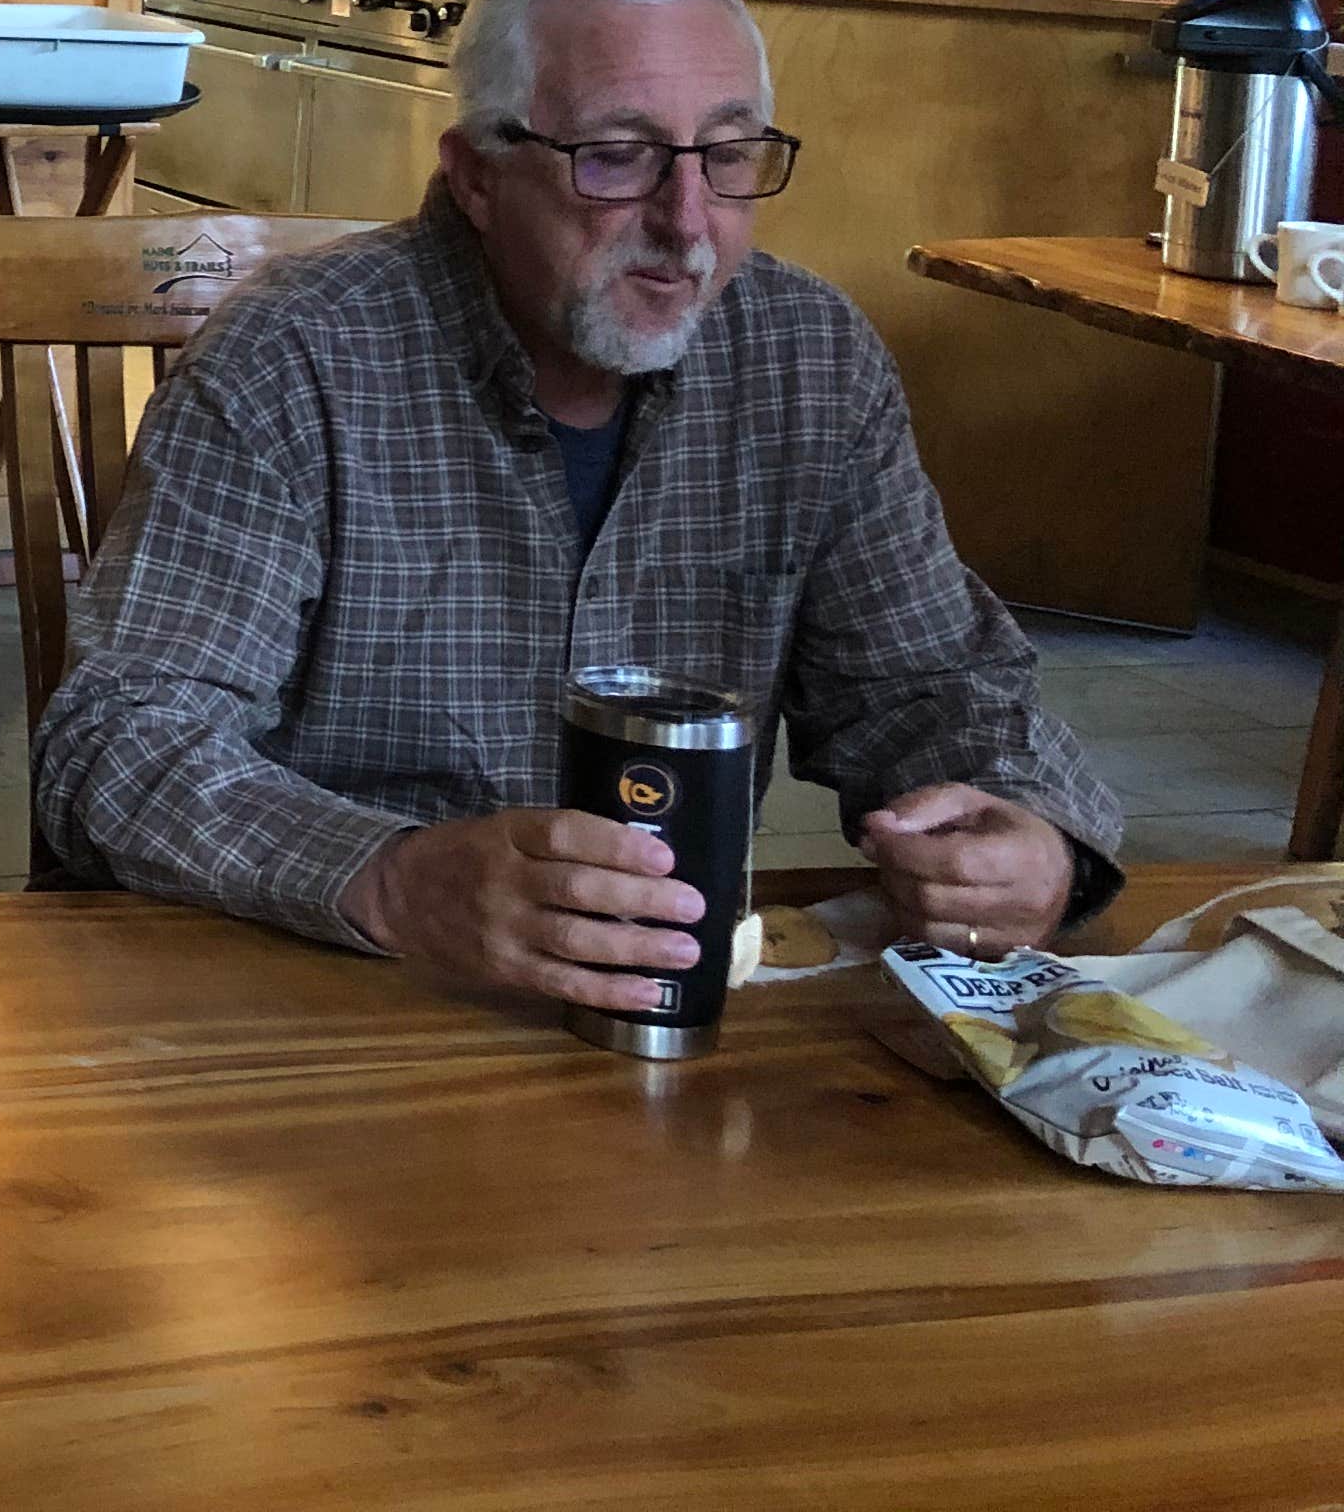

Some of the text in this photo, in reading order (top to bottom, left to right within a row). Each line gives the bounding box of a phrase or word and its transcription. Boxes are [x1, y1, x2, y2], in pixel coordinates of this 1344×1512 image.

[184, 261, 225, 272] TRAILS
[941, 974, 1023, 998] DEEP
[1200, 1068, 1248, 1092] Salt
